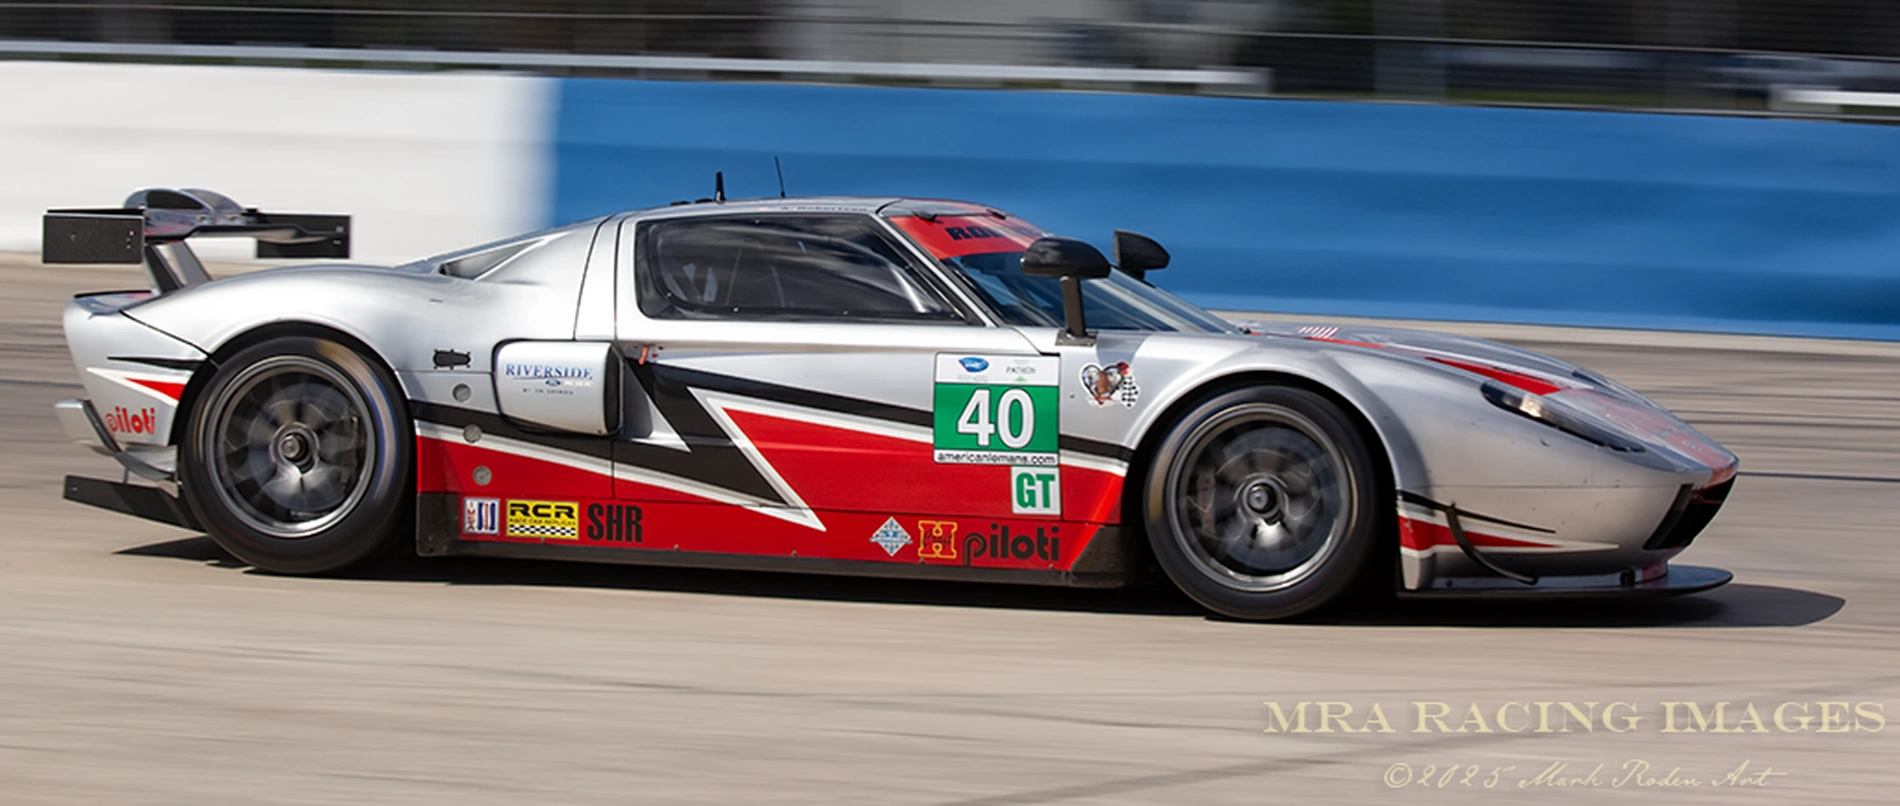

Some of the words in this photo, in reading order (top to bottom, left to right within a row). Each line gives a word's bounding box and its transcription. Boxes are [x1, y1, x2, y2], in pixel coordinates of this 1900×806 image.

[506, 364, 593, 380] RIVERSIDE
[105, 407, 155, 438] piloti
[957, 388, 1035, 449] 40
[938, 453, 1056, 464] americanlemans.com
[1016, 472, 1056, 508] GT
[510, 503, 575, 519] RCR
[587, 503, 643, 542] SHR
[962, 522, 1060, 567] piloti
